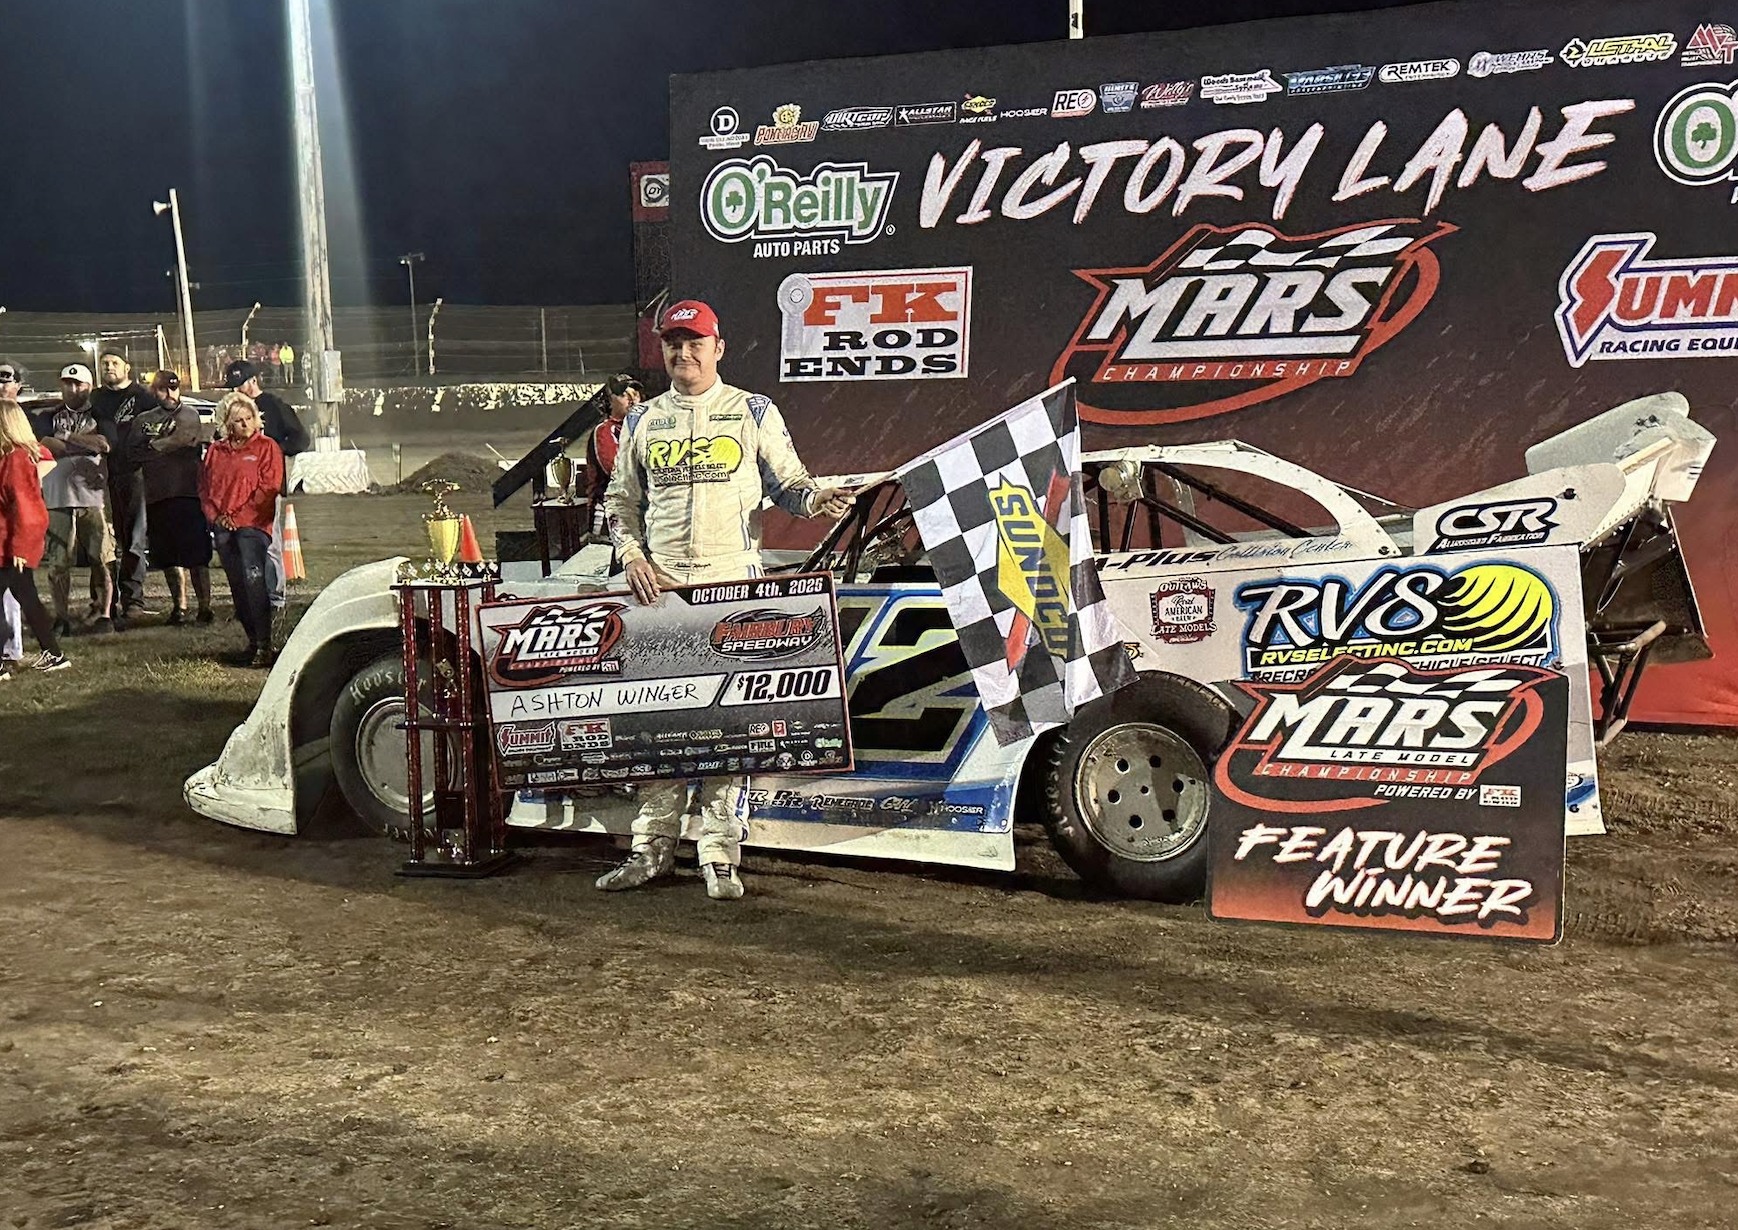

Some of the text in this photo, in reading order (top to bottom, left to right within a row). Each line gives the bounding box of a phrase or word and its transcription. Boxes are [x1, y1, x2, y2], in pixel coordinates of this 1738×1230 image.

[1586, 36, 1673, 57] LETHAL
[1388, 60, 1450, 80] REMTEK
[1000, 108, 1048, 118] HOOSIER
[920, 99, 1636, 228] VICTORY LANE
[712, 167, 883, 230] O'Reilly
[753, 239, 840, 259] AUTO PARTS
[804, 282, 958, 326] FK
[1086, 266, 1394, 359] MARS
[823, 328, 959, 351] ROD
[1599, 339, 1680, 354] RACING
[784, 353, 957, 377] ENDS
[1102, 360, 1353, 381] CHAMPIONSHIP
[1440, 501, 1553, 537] CSR
[691, 584, 750, 604] OCTOBER
[755, 582, 783, 598] 4th.
[1159, 580, 1207, 593] OUTLAWS
[1165, 606, 1203, 616] AMERICAN
[714, 617, 815, 644] FAIRBURY
[1150, 621, 1218, 636] LATE MODELS
[502, 620, 606, 661] MARS
[721, 635, 813, 652] SPEEDWAY
[559, 664, 591, 673] POWERED
[737, 669, 832, 702] $12,000
[510, 682, 700, 718] ASHTON WINGER
[501, 726, 553, 751] SUMMIT
[1248, 693, 1506, 763] MARS
[1331, 750, 1470, 764] LATE MODEL
[1260, 763, 1473, 782] CHAMPIONSHIP
[1373, 784, 1453, 799] POWERED
[1456, 788, 1478, 800] BY
[1234, 822, 1511, 874] FEATURE
[1305, 866, 1533, 919] WINNER
